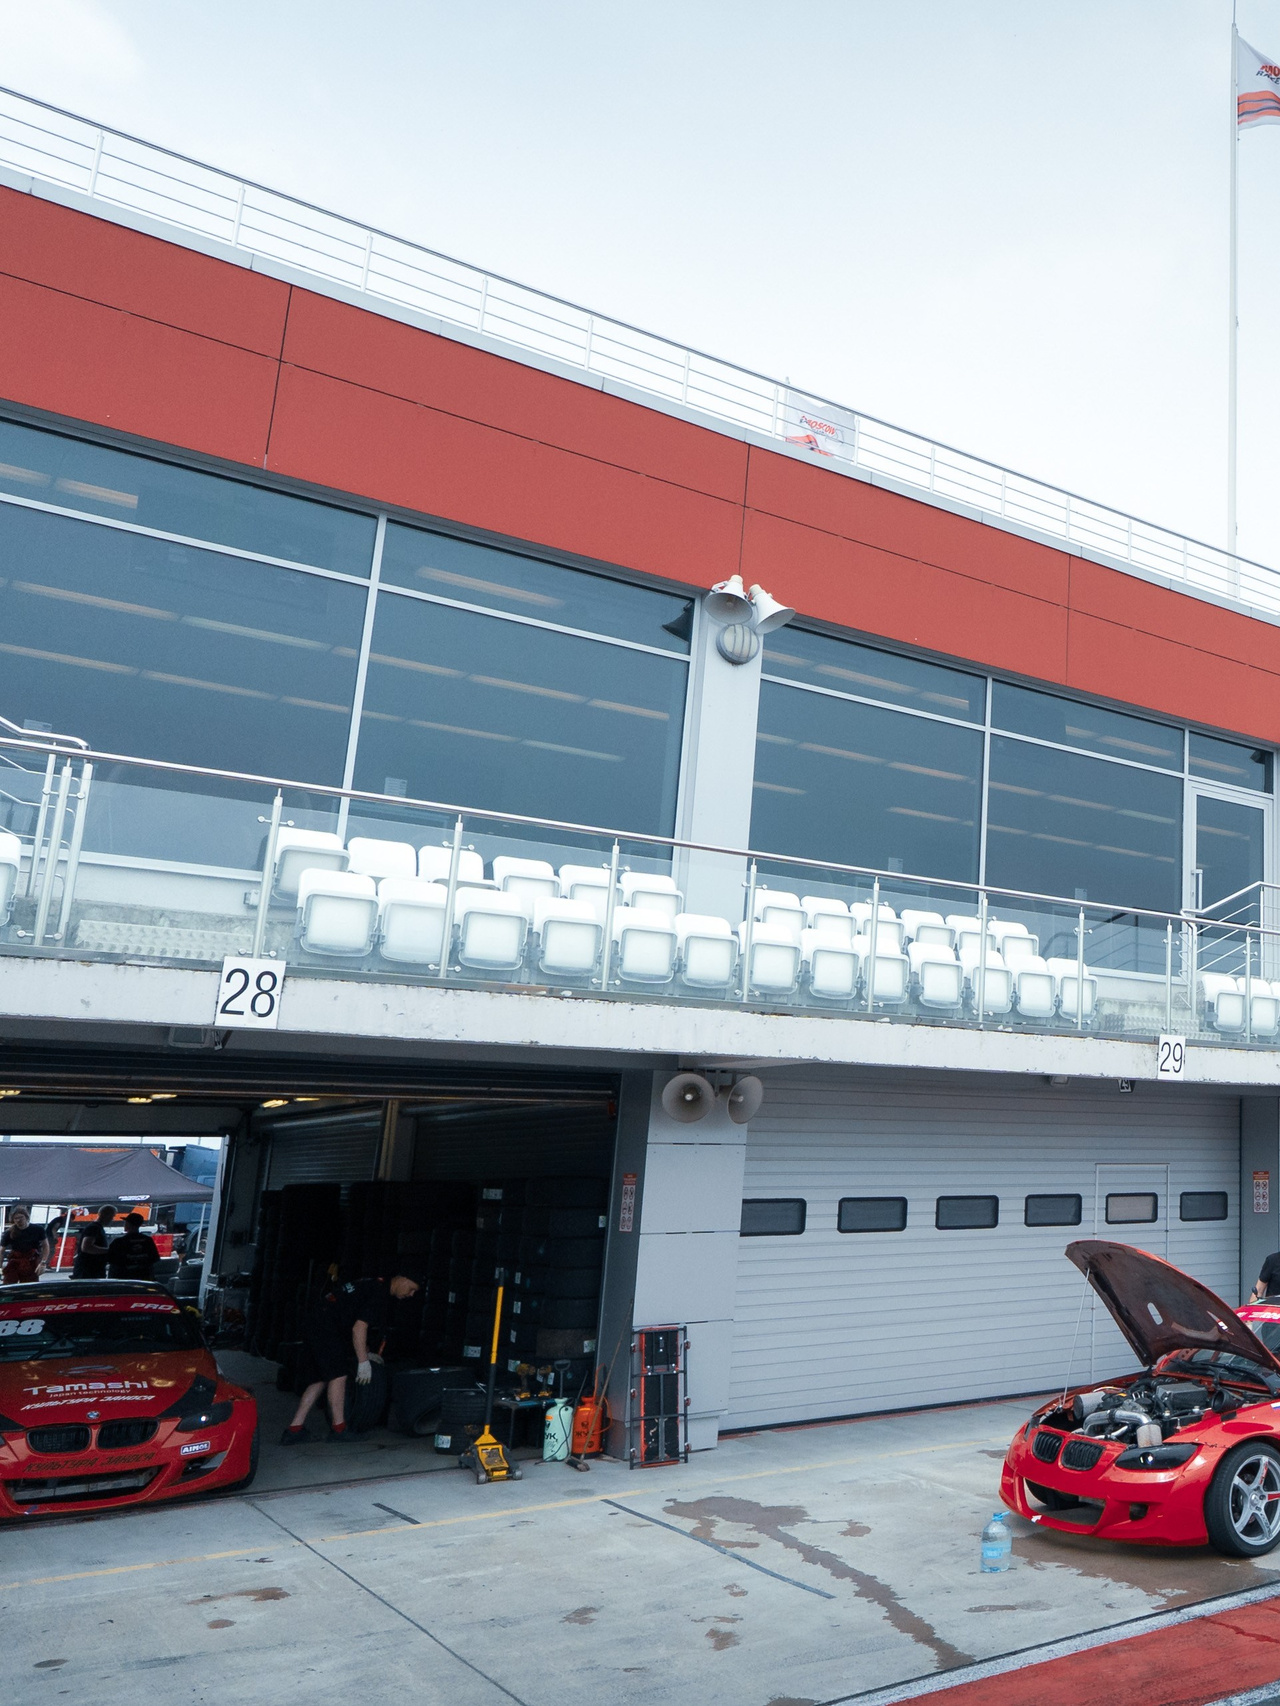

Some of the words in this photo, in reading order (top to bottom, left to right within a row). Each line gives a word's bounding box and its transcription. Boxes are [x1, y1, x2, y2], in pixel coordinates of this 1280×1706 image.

[220, 968, 278, 1018] 28
[1160, 1041, 1183, 1073] 29
[130, 1302, 174, 1311] PRO
[0, 1319, 46, 1337] 88
[23, 1380, 148, 1396] Tamashi
